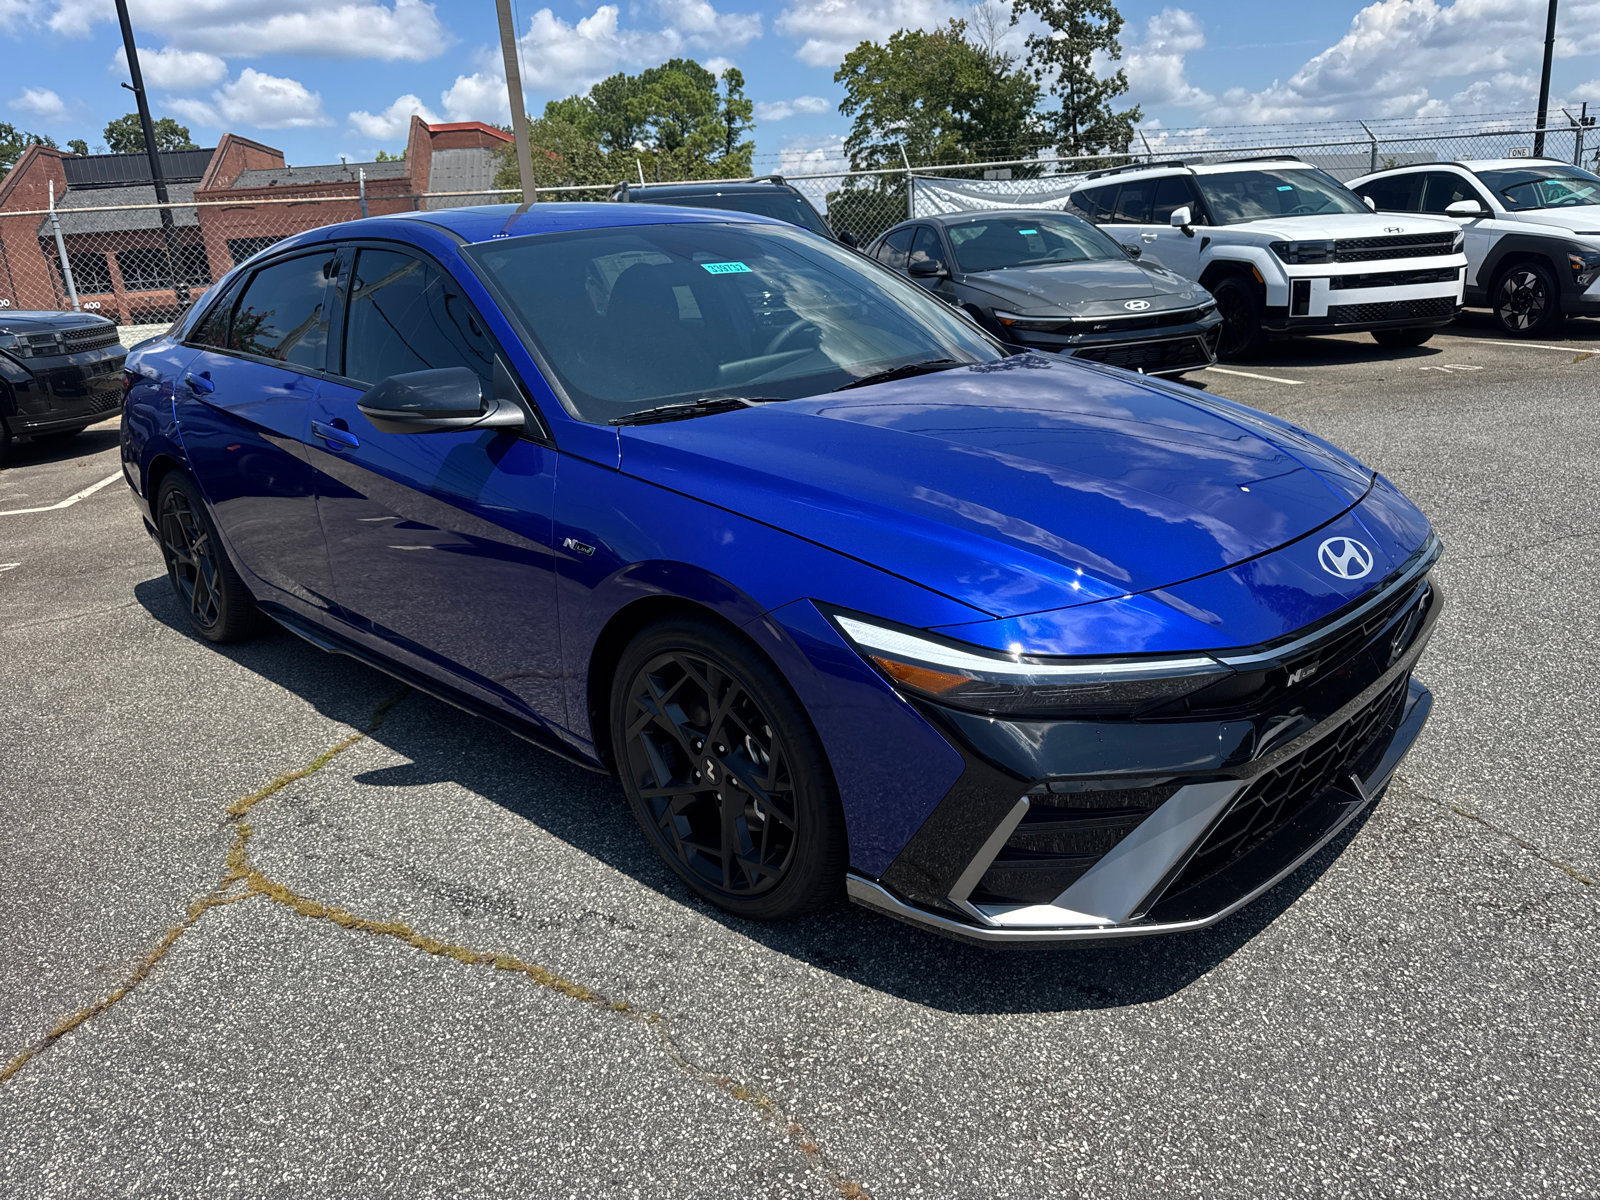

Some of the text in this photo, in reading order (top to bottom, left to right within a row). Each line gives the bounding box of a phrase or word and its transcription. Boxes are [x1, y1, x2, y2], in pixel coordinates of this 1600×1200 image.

[1512, 149, 1527, 157] ONE
[707, 264, 746, 273] 339732
[83, 301, 101, 309] 400
